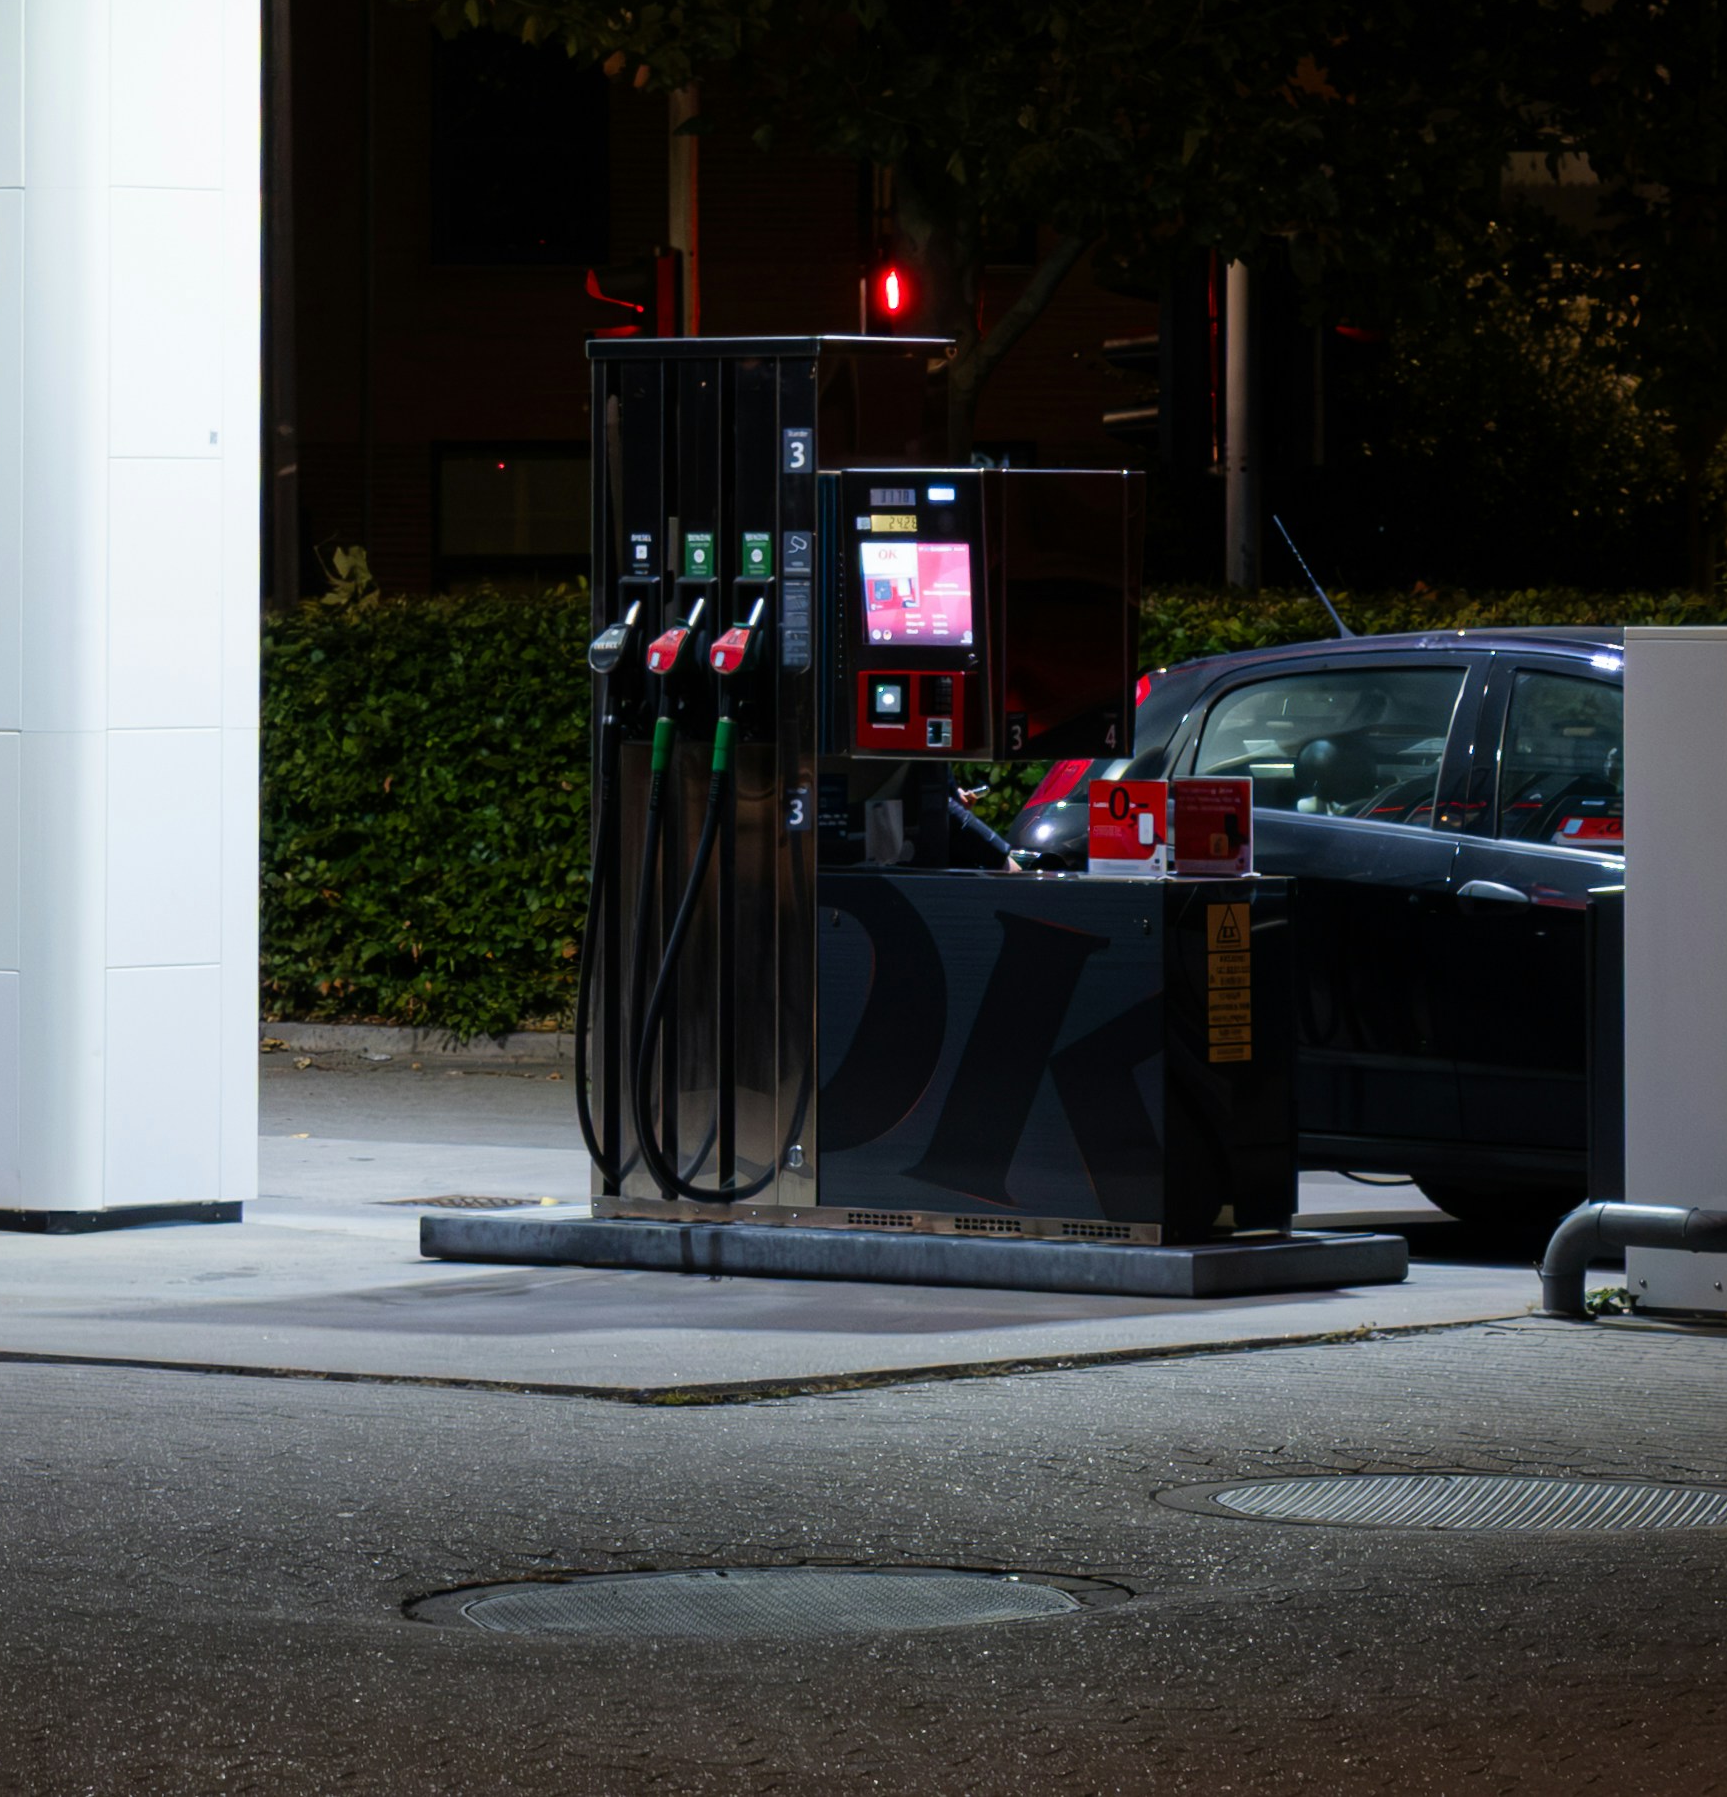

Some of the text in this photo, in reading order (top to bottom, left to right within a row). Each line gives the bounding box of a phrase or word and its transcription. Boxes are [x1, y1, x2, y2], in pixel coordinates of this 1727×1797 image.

[790, 442, 805, 468] 3
[878, 548, 898, 561] OK
[1011, 724, 1022, 751] 3
[1105, 724, 1116, 749] 4
[789, 799, 804, 825] 3
